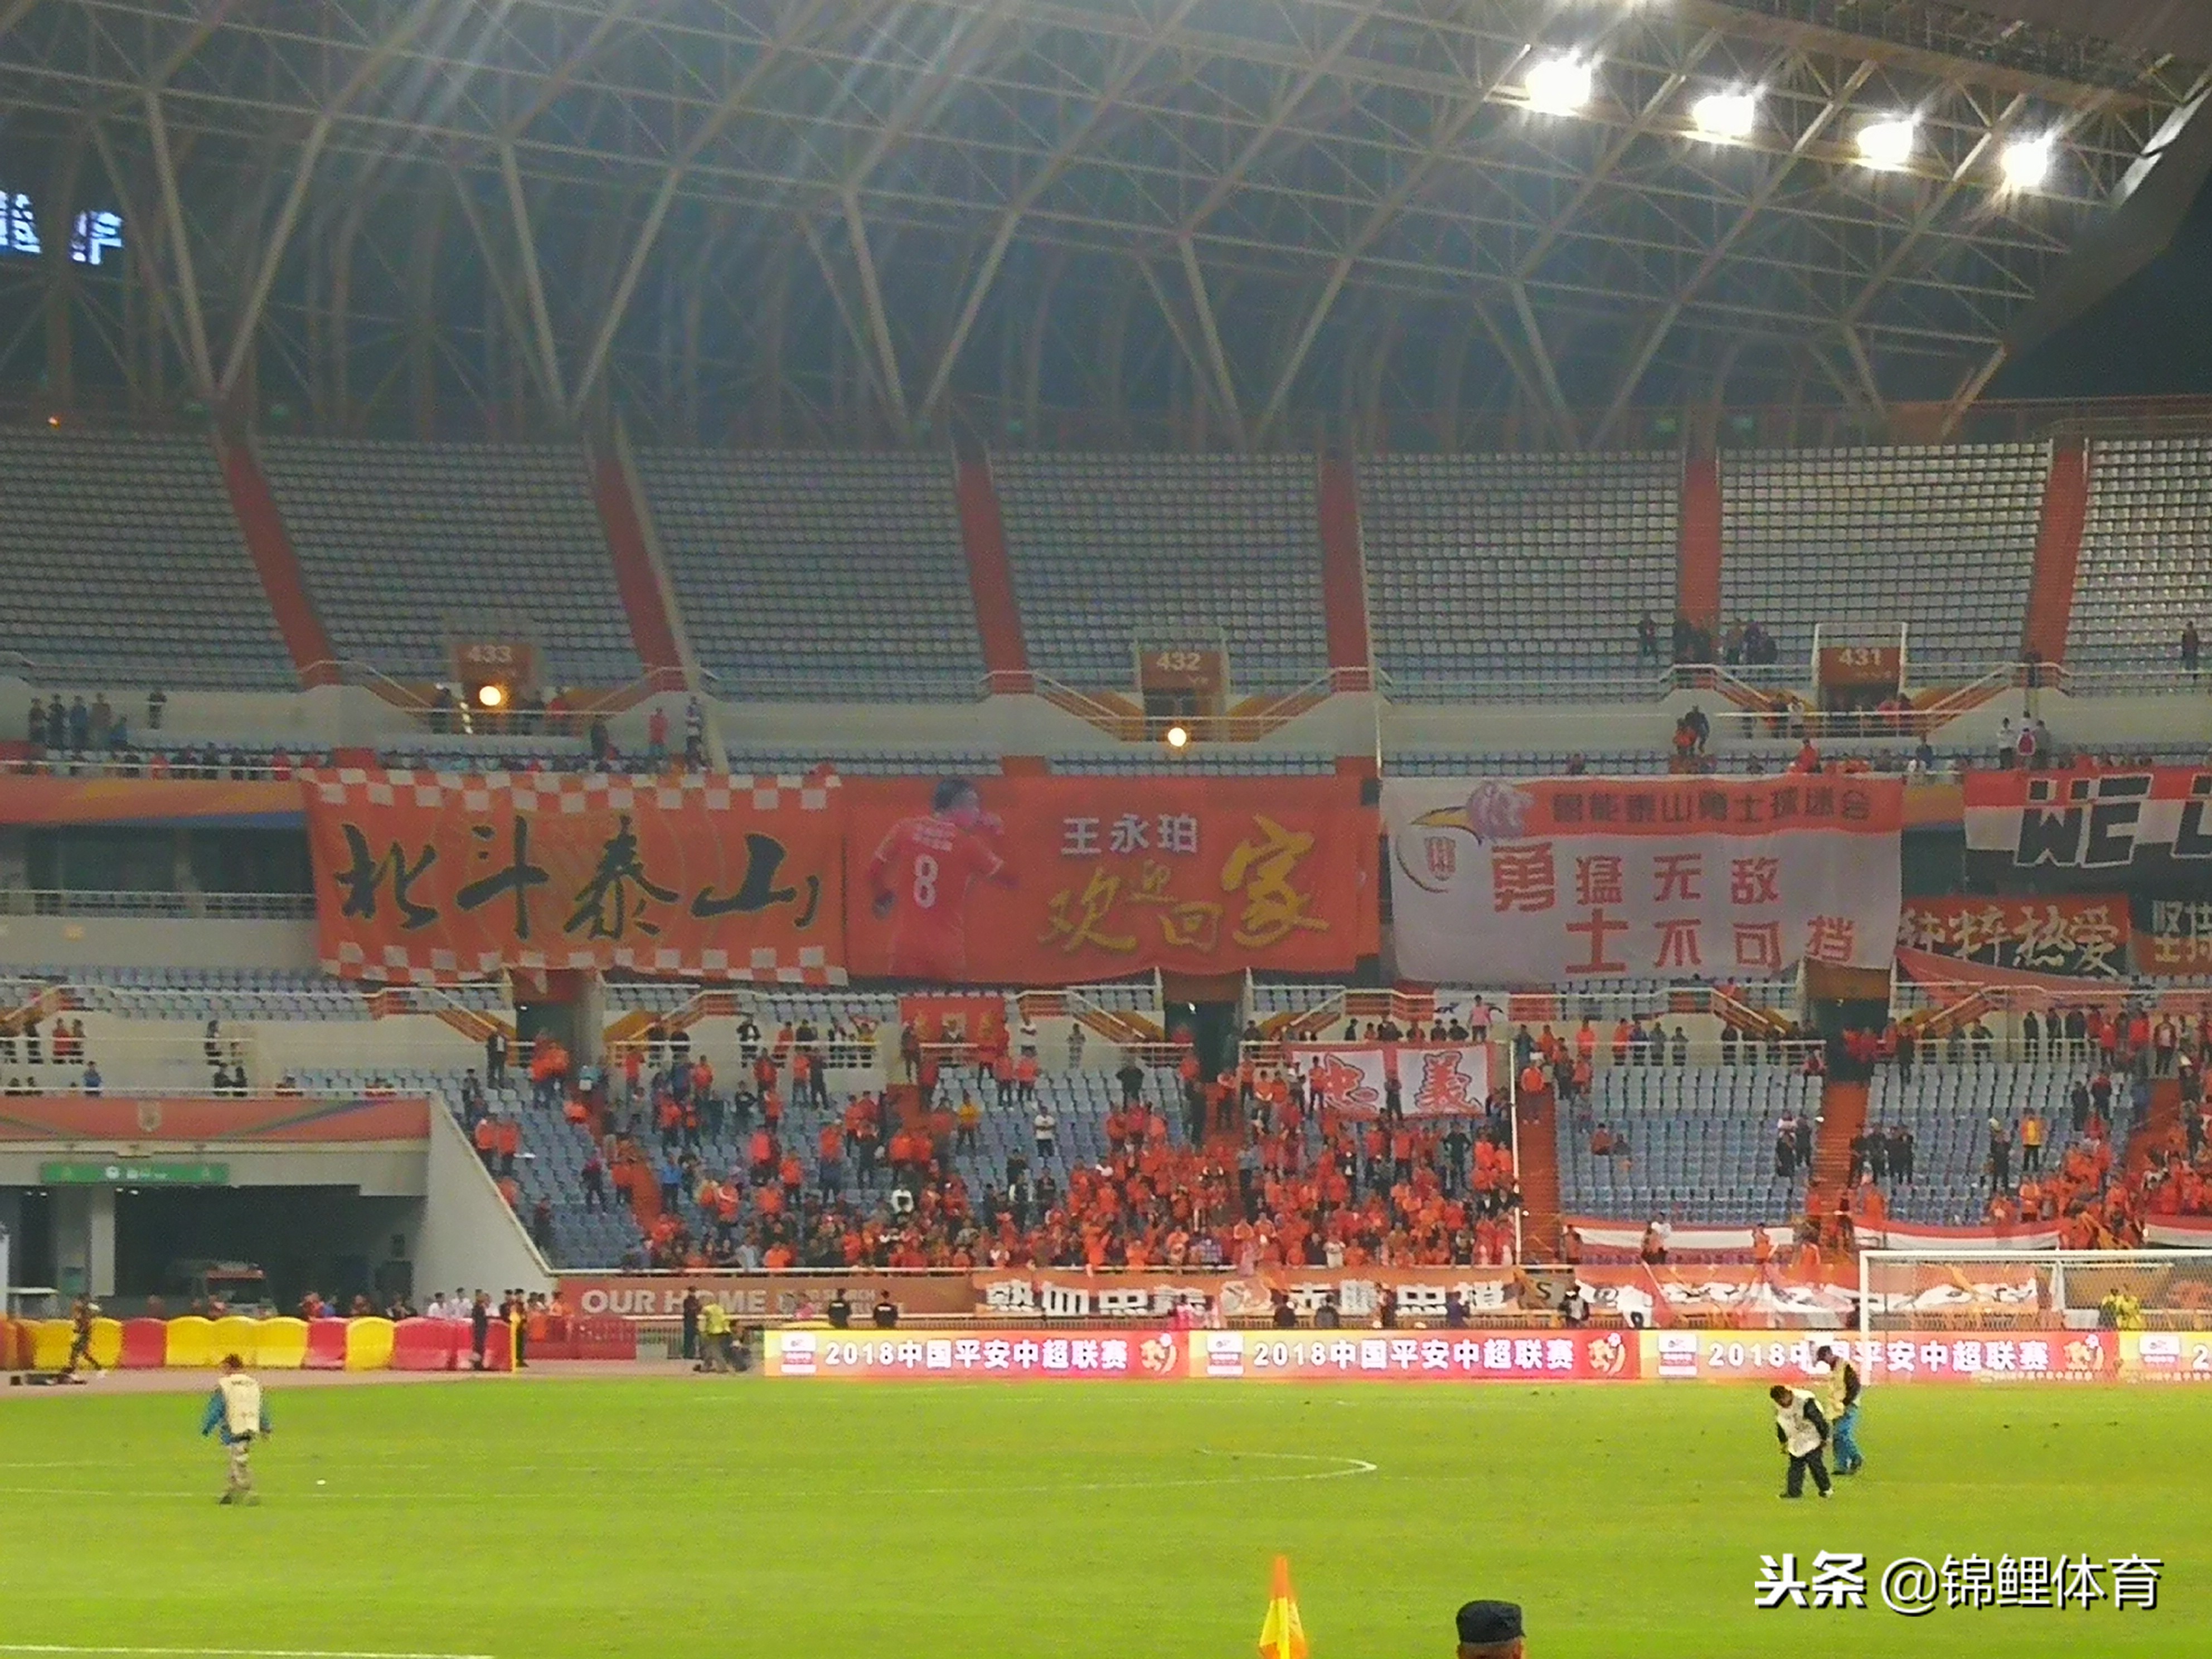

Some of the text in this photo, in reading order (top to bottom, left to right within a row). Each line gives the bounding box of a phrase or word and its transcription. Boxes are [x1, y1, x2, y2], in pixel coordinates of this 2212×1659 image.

[468, 645, 512, 662] 433
[1156, 651, 1201, 671] 432
[1839, 648, 1881, 666] 431
[1062, 813, 1199, 855] 王永珀
[2014, 773, 2153, 868] WE
[333, 814, 819, 940] 北斗泰山
[914, 854, 938, 909] 8
[1039, 814, 1329, 954] 欢迎回家
[1491, 842, 1779, 912] 勇猛无敌
[1565, 909, 1855, 974] 士不可挡
[581, 1288, 656, 1313] OUR
[825, 1338, 1128, 1371] 2018中国平安中超联赛
[1254, 1338, 1573, 1371] 2018中国平安中超联赛
